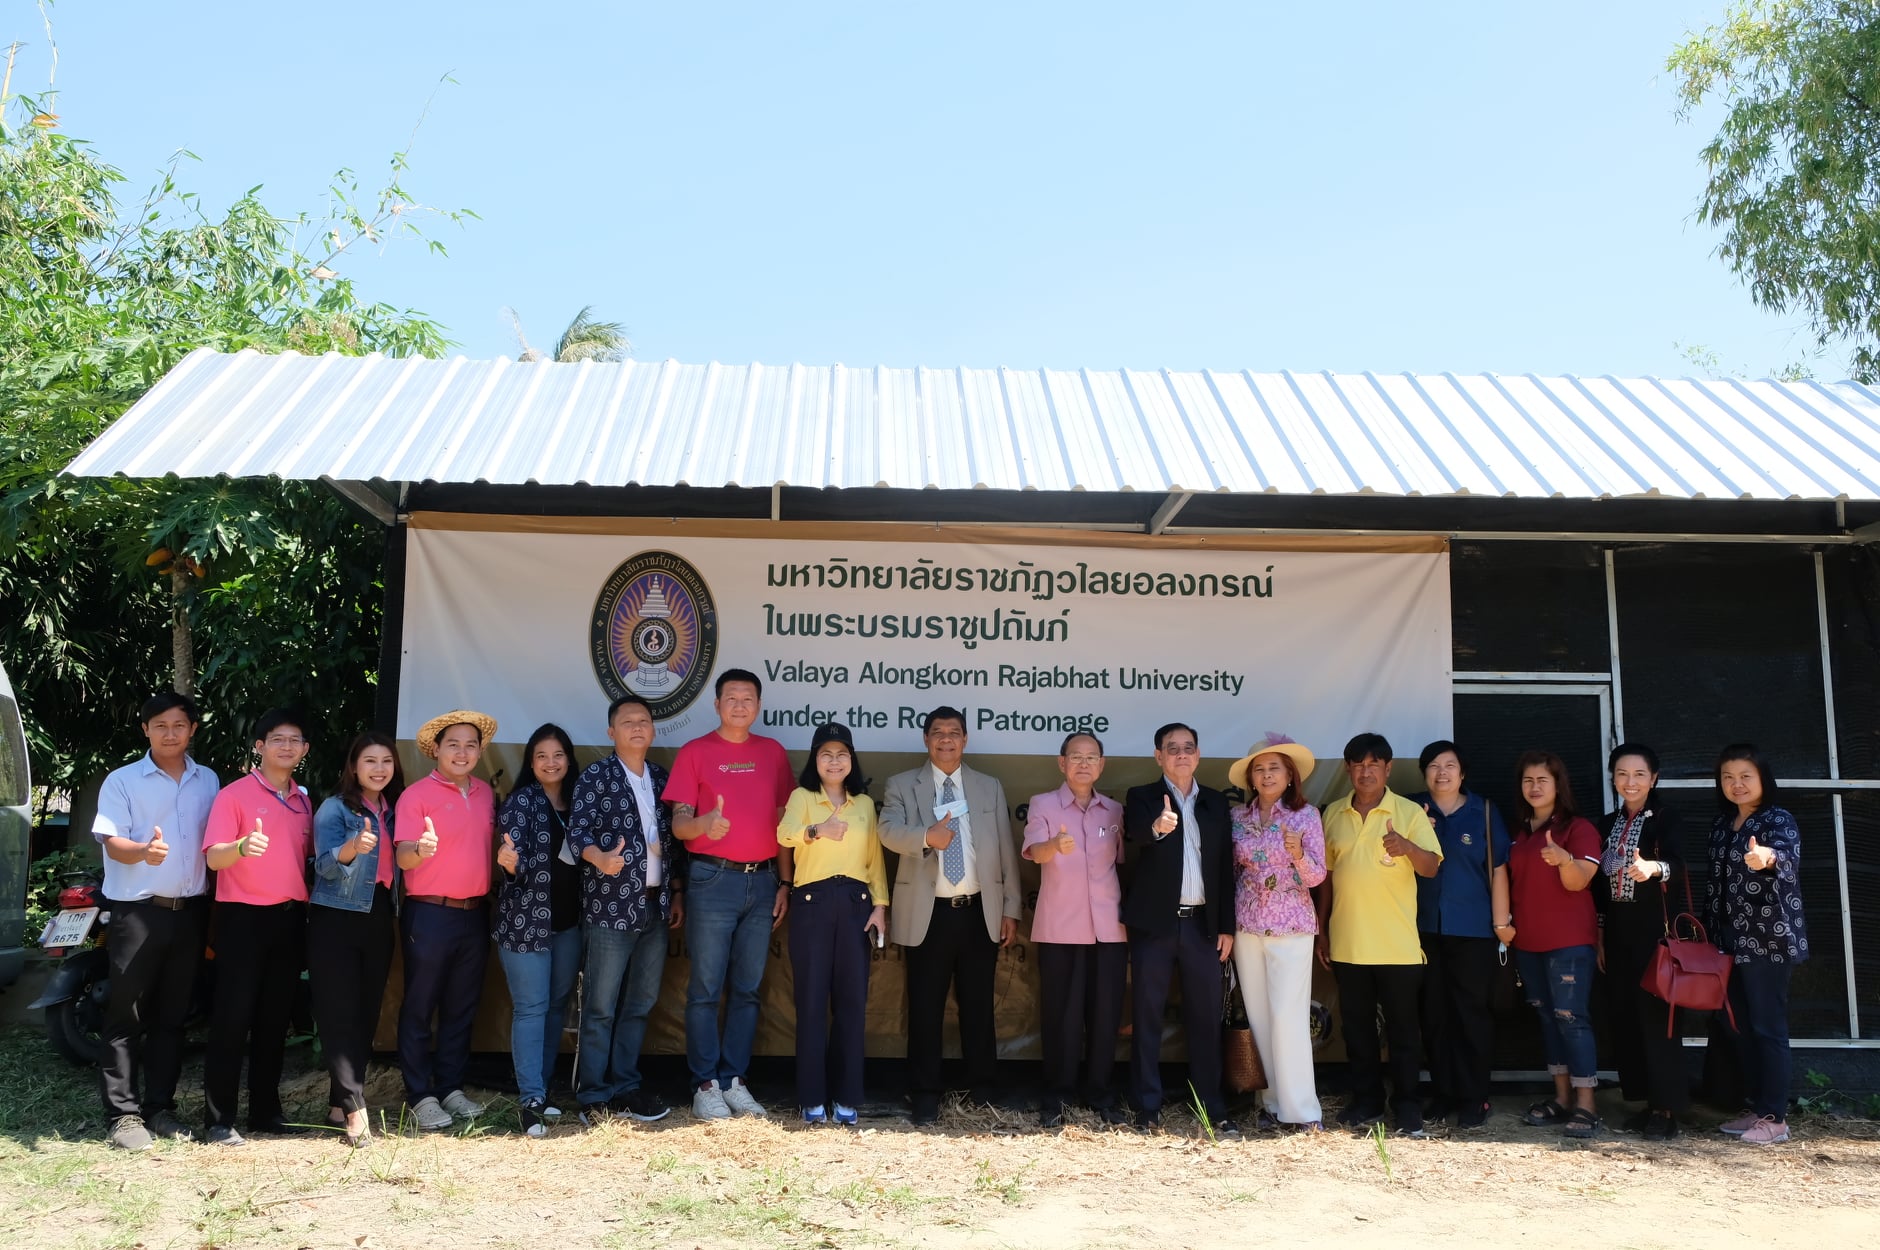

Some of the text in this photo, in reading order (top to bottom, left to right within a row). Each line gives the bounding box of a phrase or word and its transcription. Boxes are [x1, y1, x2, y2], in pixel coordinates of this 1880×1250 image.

[767, 557, 1274, 600] มหาวิทยาลัยราชภัฏวไลยอลงกรณ์
[762, 603, 1070, 649] ในพระบรมราชูปถัมภ์
[652, 641, 712, 716] RAJABHAT UNIVERSITY
[763, 659, 1245, 697] Valaya Alongkorn Rajabhat University
[762, 703, 837, 727] under
[846, 704, 889, 729] the
[977, 708, 1110, 735] Patronage
